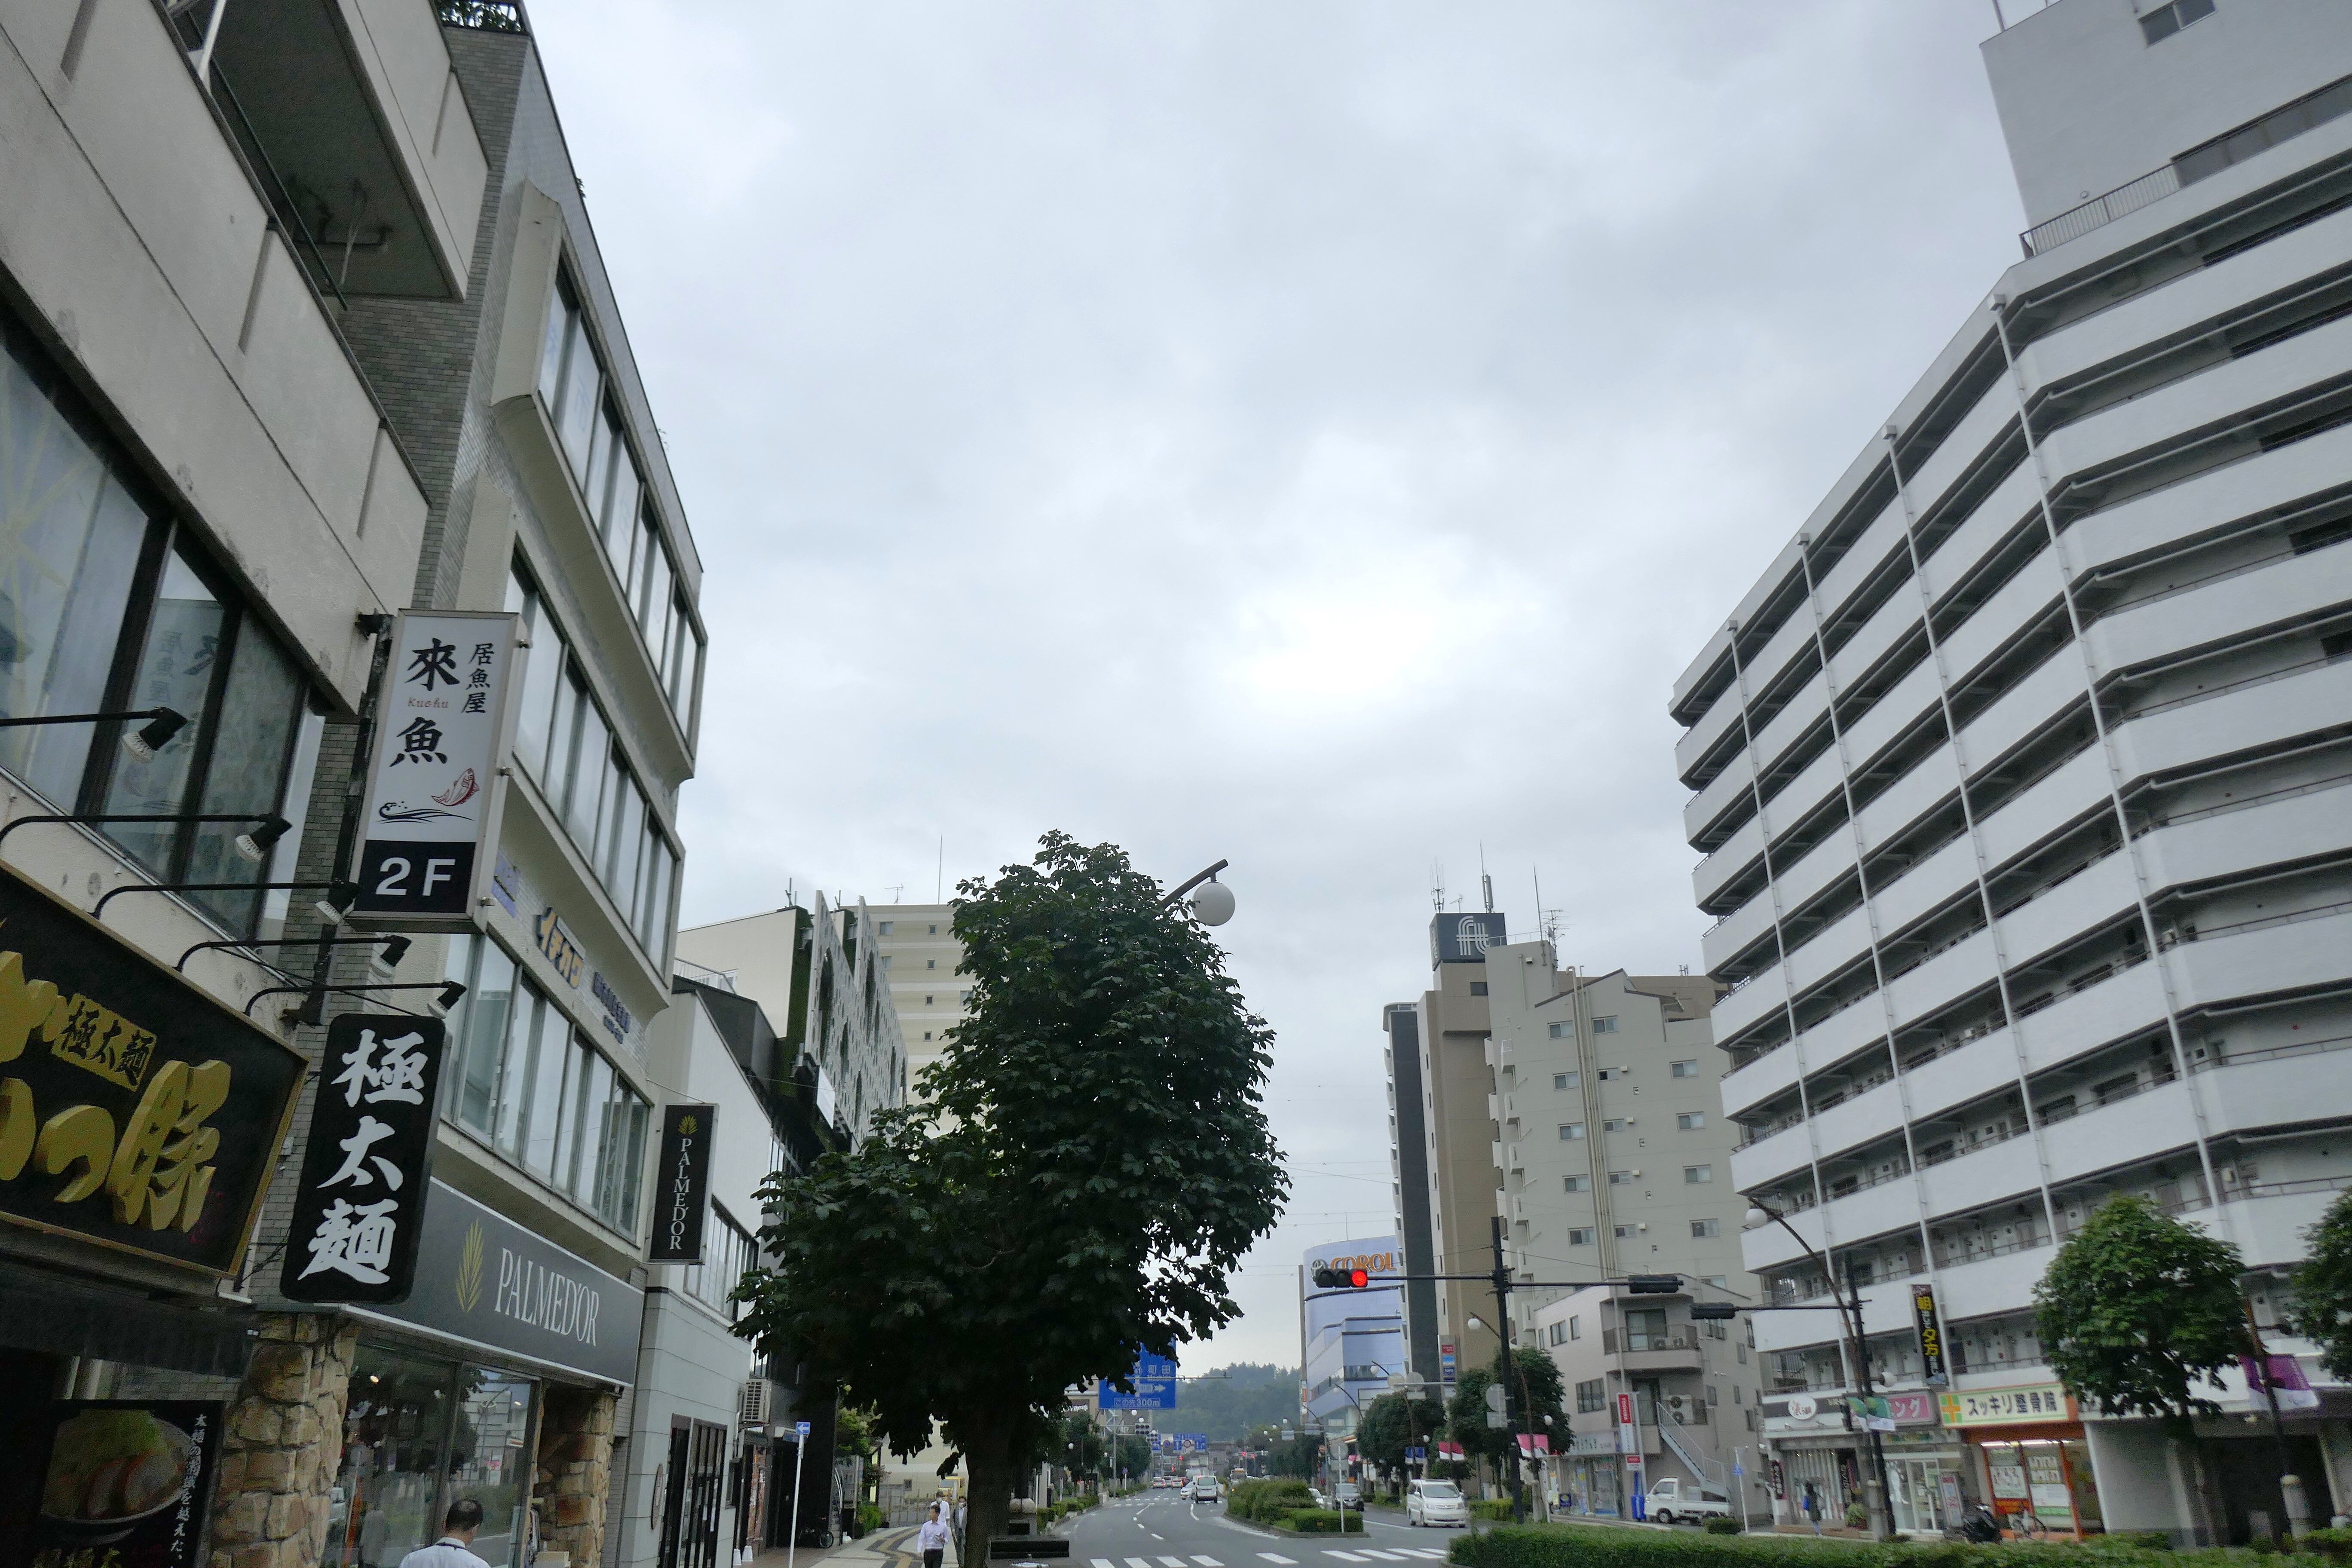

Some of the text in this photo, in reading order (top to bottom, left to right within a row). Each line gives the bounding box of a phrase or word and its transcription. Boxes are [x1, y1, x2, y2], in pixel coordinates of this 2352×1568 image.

[461, 643, 495, 714] 居魚屋
[1148, 1365, 1170, 1374] 町田
[1966, 1390, 2058, 1417] スッキリ整骨院
